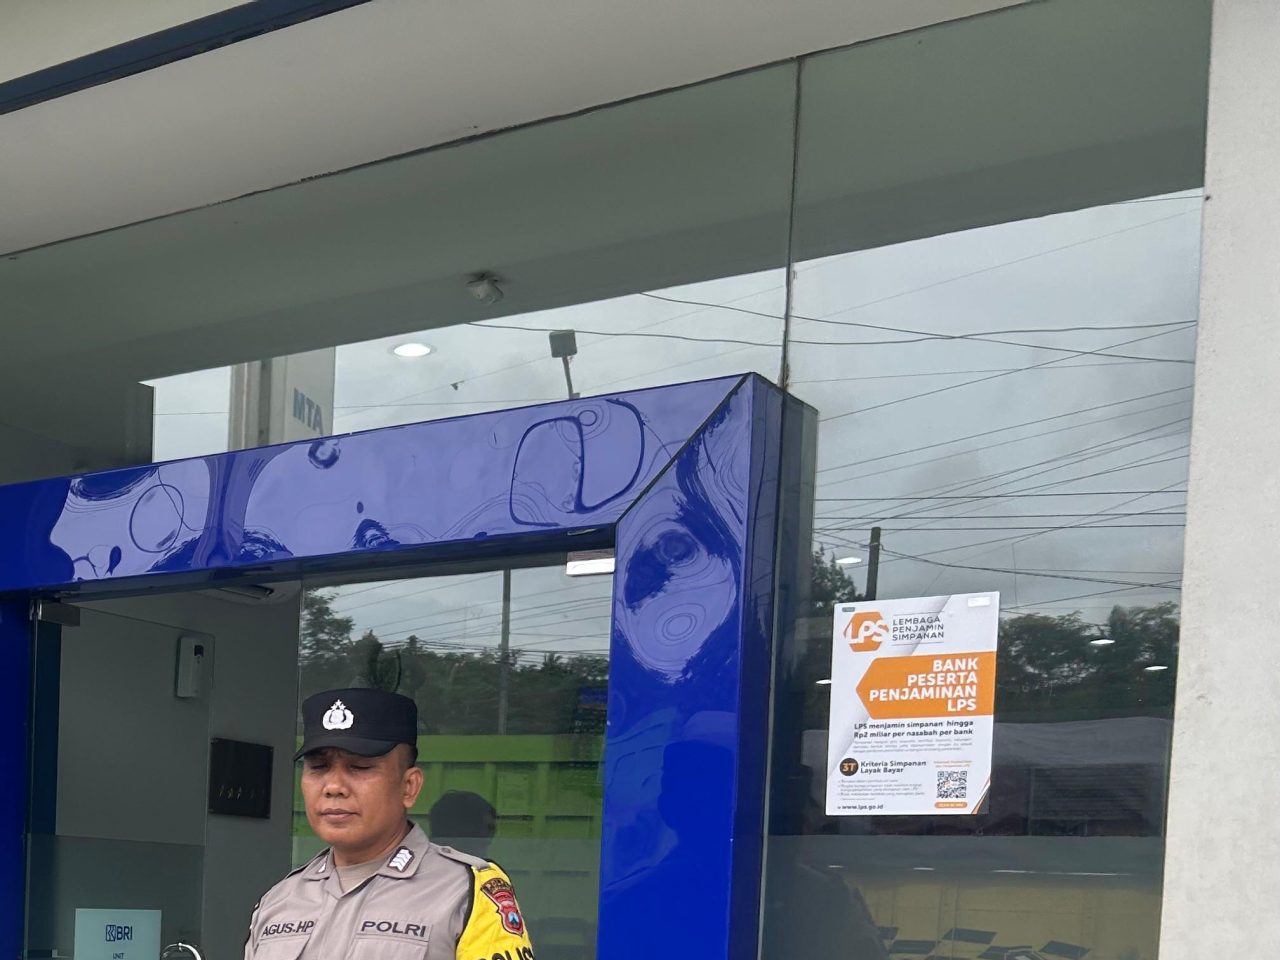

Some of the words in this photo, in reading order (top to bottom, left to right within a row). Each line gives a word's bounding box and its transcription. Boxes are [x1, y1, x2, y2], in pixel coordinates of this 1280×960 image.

[892, 616, 941, 626] LEMBAGA
[847, 619, 889, 644] LPS
[892, 624, 944, 633] PENJAMIN
[892, 632, 945, 641] SIMPANAN
[933, 657, 979, 672] BANK
[907, 672, 978, 687] PESERTA
[869, 685, 977, 702] PENJAMINAN
[947, 698, 977, 712] LPS
[868, 722, 905, 731] menjamin
[946, 720, 974, 728] hingga
[853, 731, 868, 739] Rp2
[892, 731, 905, 739] per
[906, 729, 938, 737] nasabah
[939, 730, 952, 738] per
[953, 728, 974, 736] bank
[842, 762, 857, 773] 3T
[860, 760, 888, 768] Kriteria
[889, 759, 927, 769] Simpanan
[860, 767, 881, 775] Layak
[882, 767, 904, 775] Bayar
[116, 926, 133, 941] BRI
[262, 920, 314, 937] AGUS.HP
[361, 920, 427, 938] POLRI
[112, 952, 125, 960] UNIT
